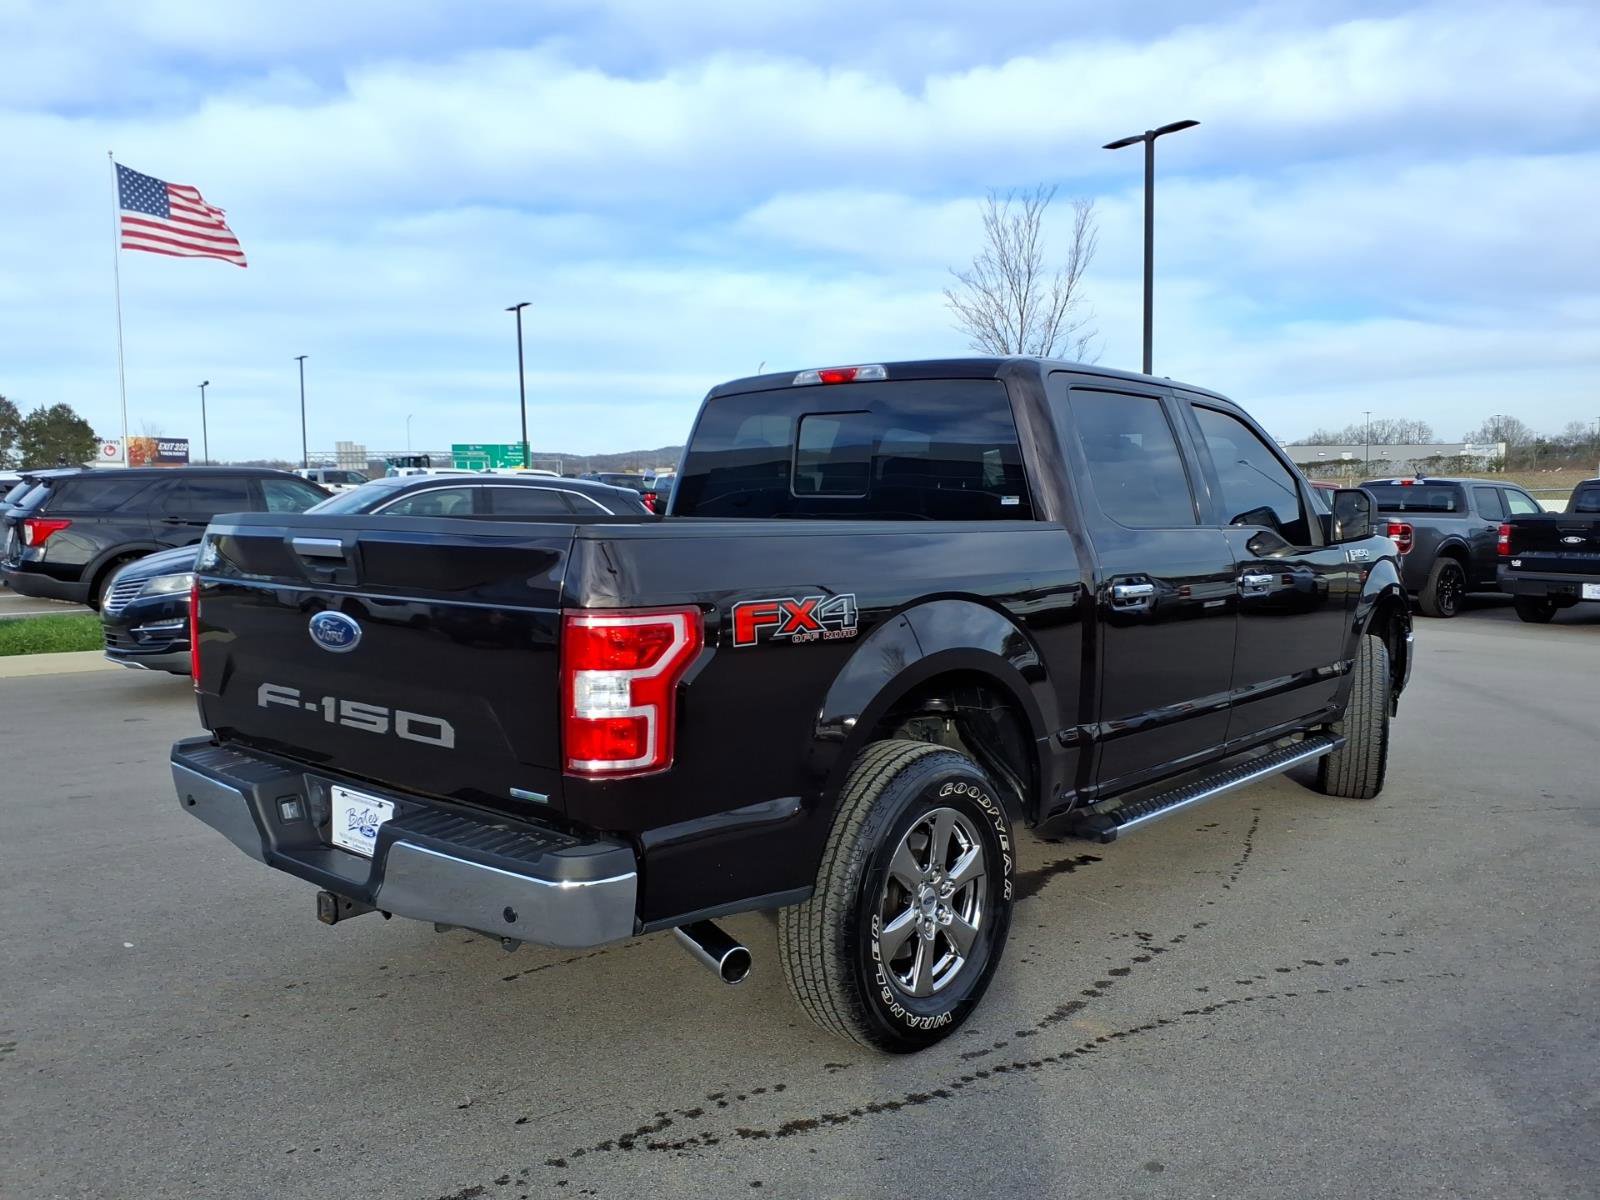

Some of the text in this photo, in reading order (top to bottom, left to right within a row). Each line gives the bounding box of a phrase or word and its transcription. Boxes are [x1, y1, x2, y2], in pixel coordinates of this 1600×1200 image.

[158, 442, 174, 450] EXIT
[317, 619, 346, 643] Ford
[731, 593, 859, 648] FX4
[791, 628, 858, 644] OFF ROAD
[257, 683, 455, 749] F-150
[346, 808, 378, 827] Bates
[939, 782, 1013, 901] GOODYEAR
[871, 914, 953, 1030] WRANGLER
